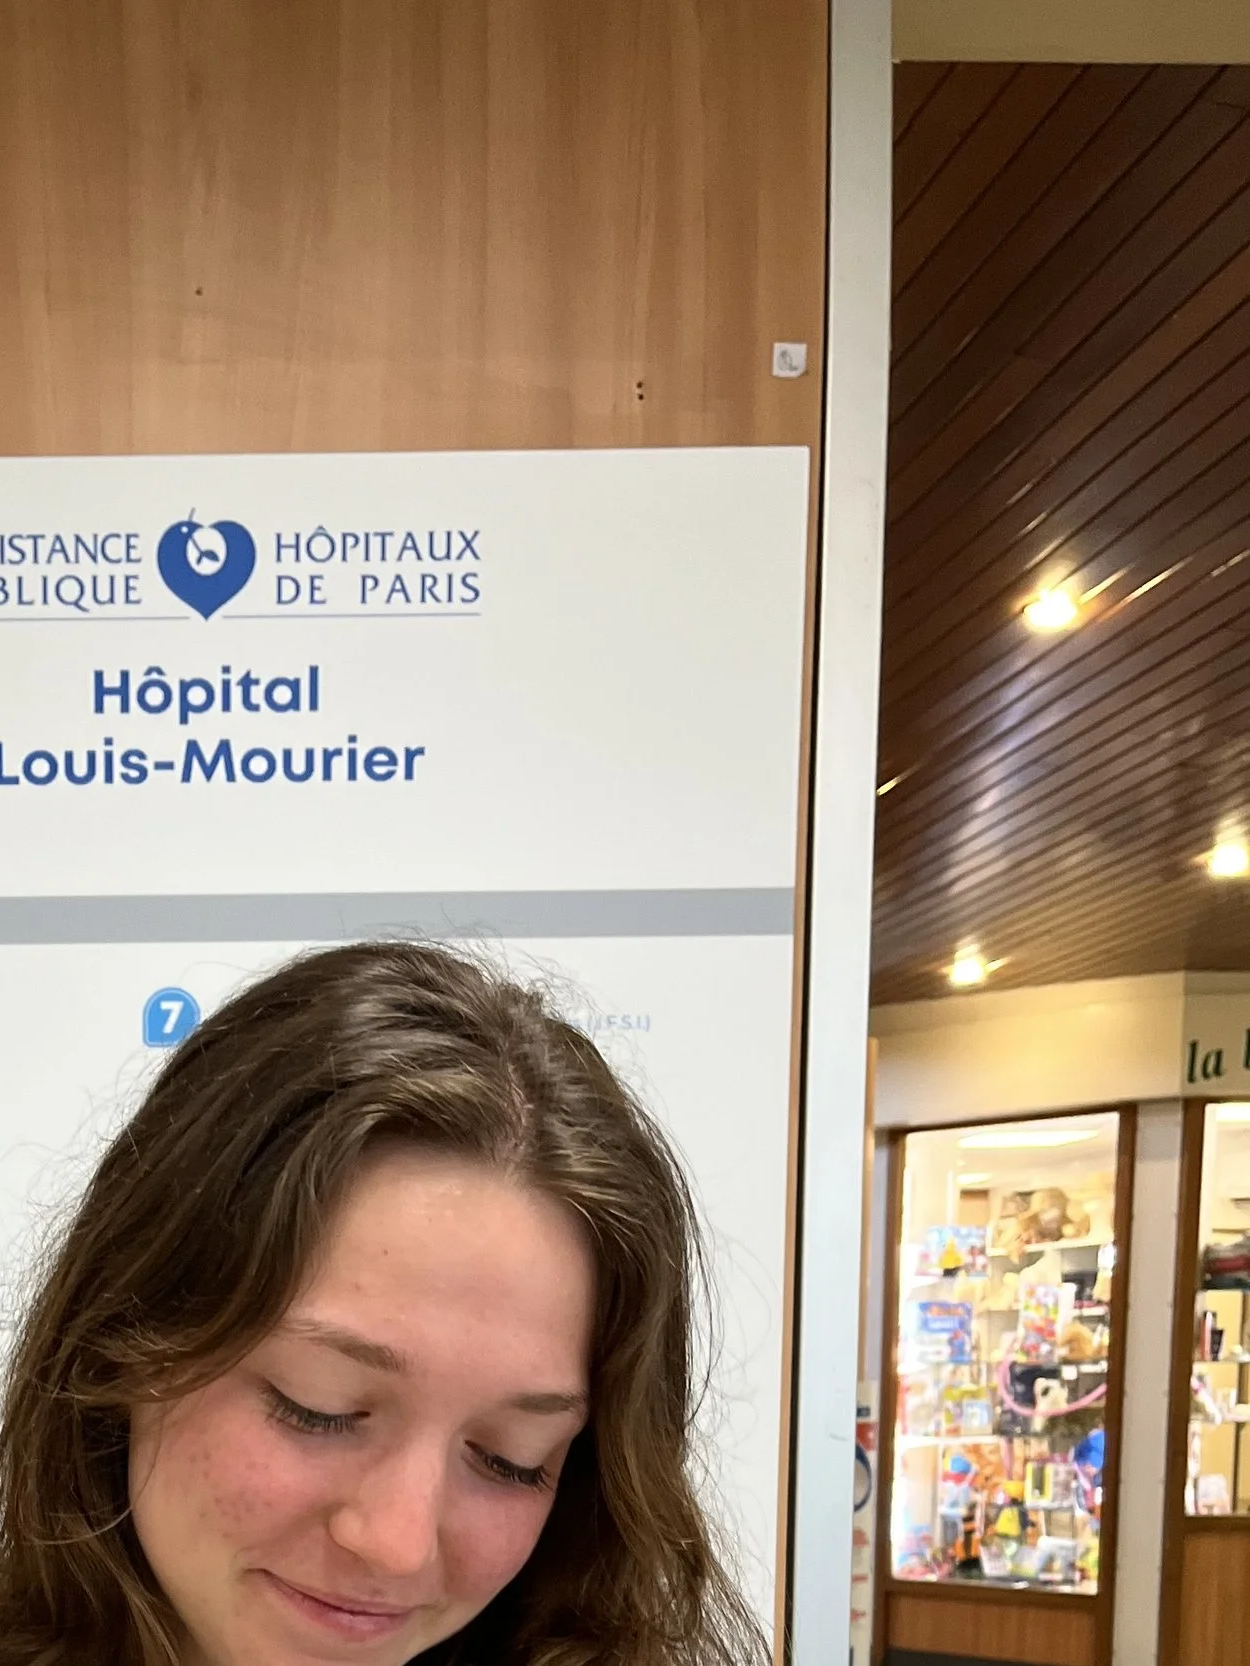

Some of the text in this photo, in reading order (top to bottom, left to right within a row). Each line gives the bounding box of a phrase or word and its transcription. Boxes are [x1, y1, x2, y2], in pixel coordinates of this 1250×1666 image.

[275, 526, 481, 563] HÔPITAUX
[276, 573, 481, 606] DE PARIS
[93, 664, 319, 725] Hôpital
[160, 1001, 184, 1034] 7
[1188, 1039, 1223, 1083] la
